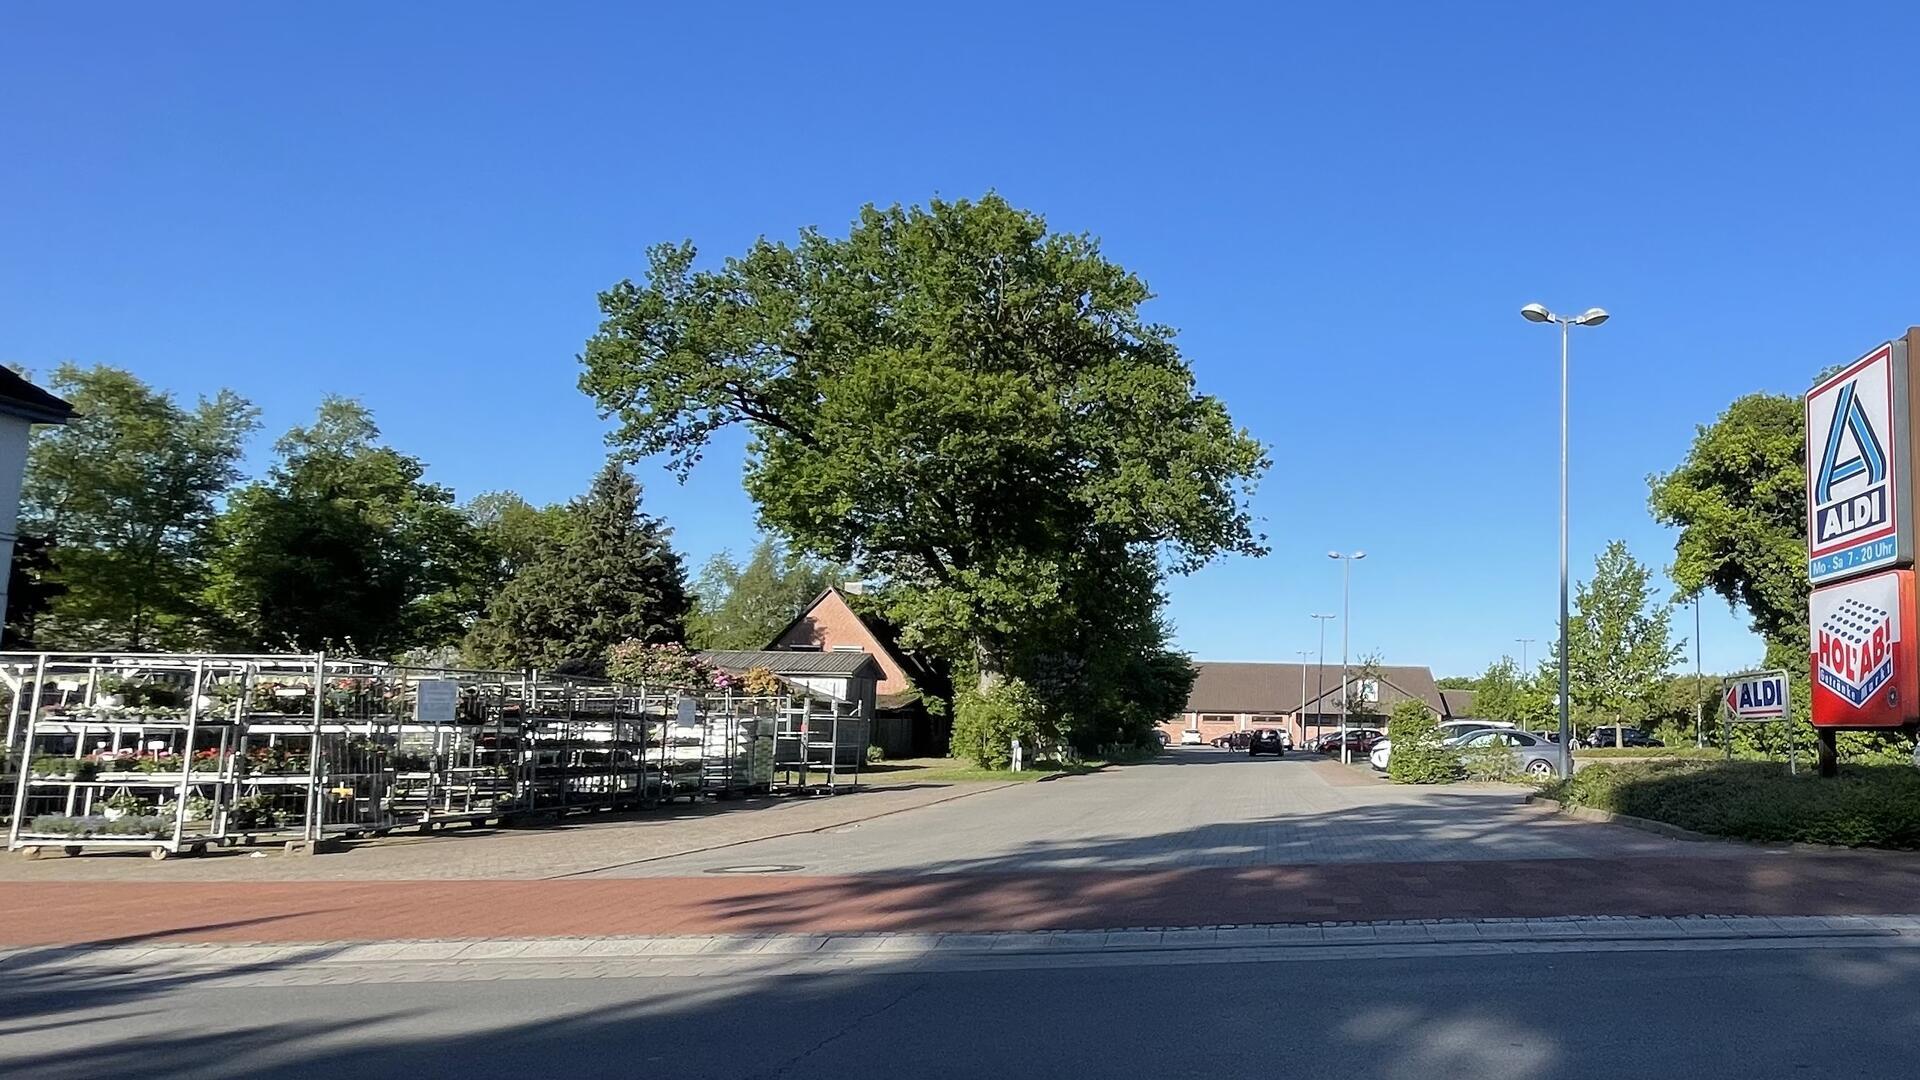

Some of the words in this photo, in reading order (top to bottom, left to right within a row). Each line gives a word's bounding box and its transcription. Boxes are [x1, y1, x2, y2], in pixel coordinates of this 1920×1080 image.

[1822, 490, 1880, 540] ALDI
[1813, 561, 1827, 575] Mo
[1832, 555, 1844, 570] Sa
[1847, 551, 1853, 566] 7
[1861, 545, 1873, 562] 20
[1875, 541, 1893, 558] Uhr
[1739, 679, 1782, 708] ALDI
